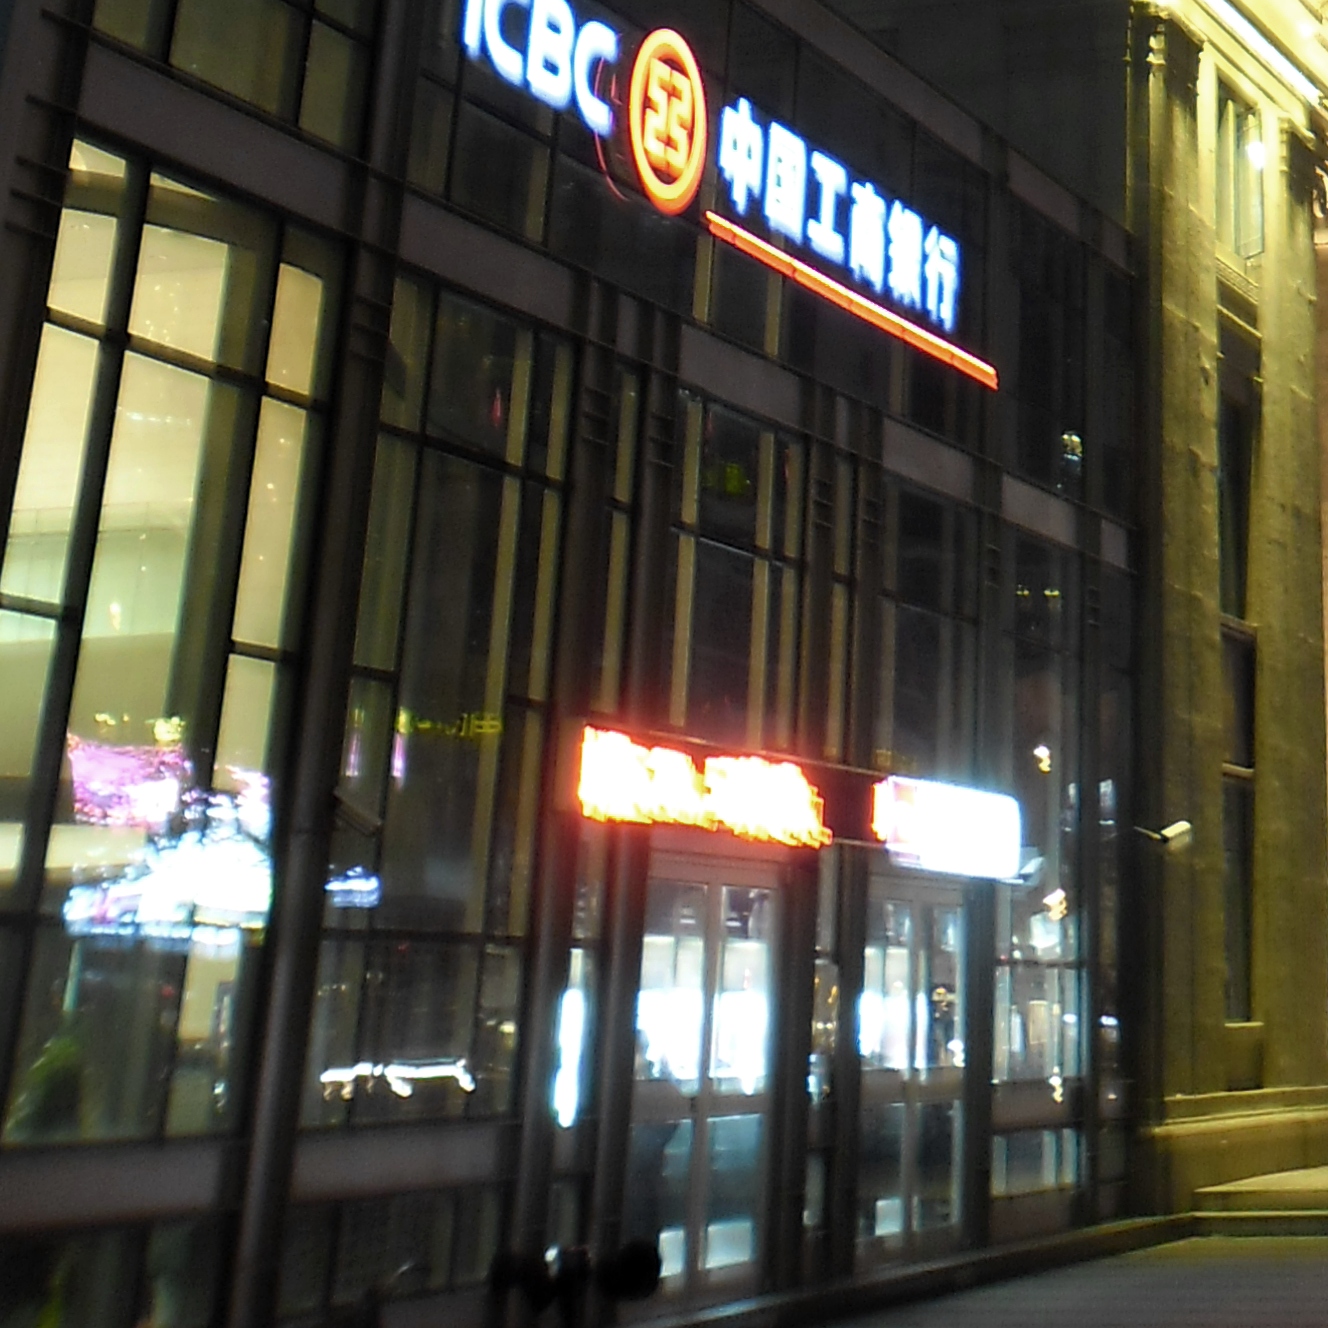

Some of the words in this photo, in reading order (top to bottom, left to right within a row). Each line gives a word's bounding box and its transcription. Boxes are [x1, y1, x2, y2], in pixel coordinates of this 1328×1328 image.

[718, 97, 961, 333] 中国工商银行
